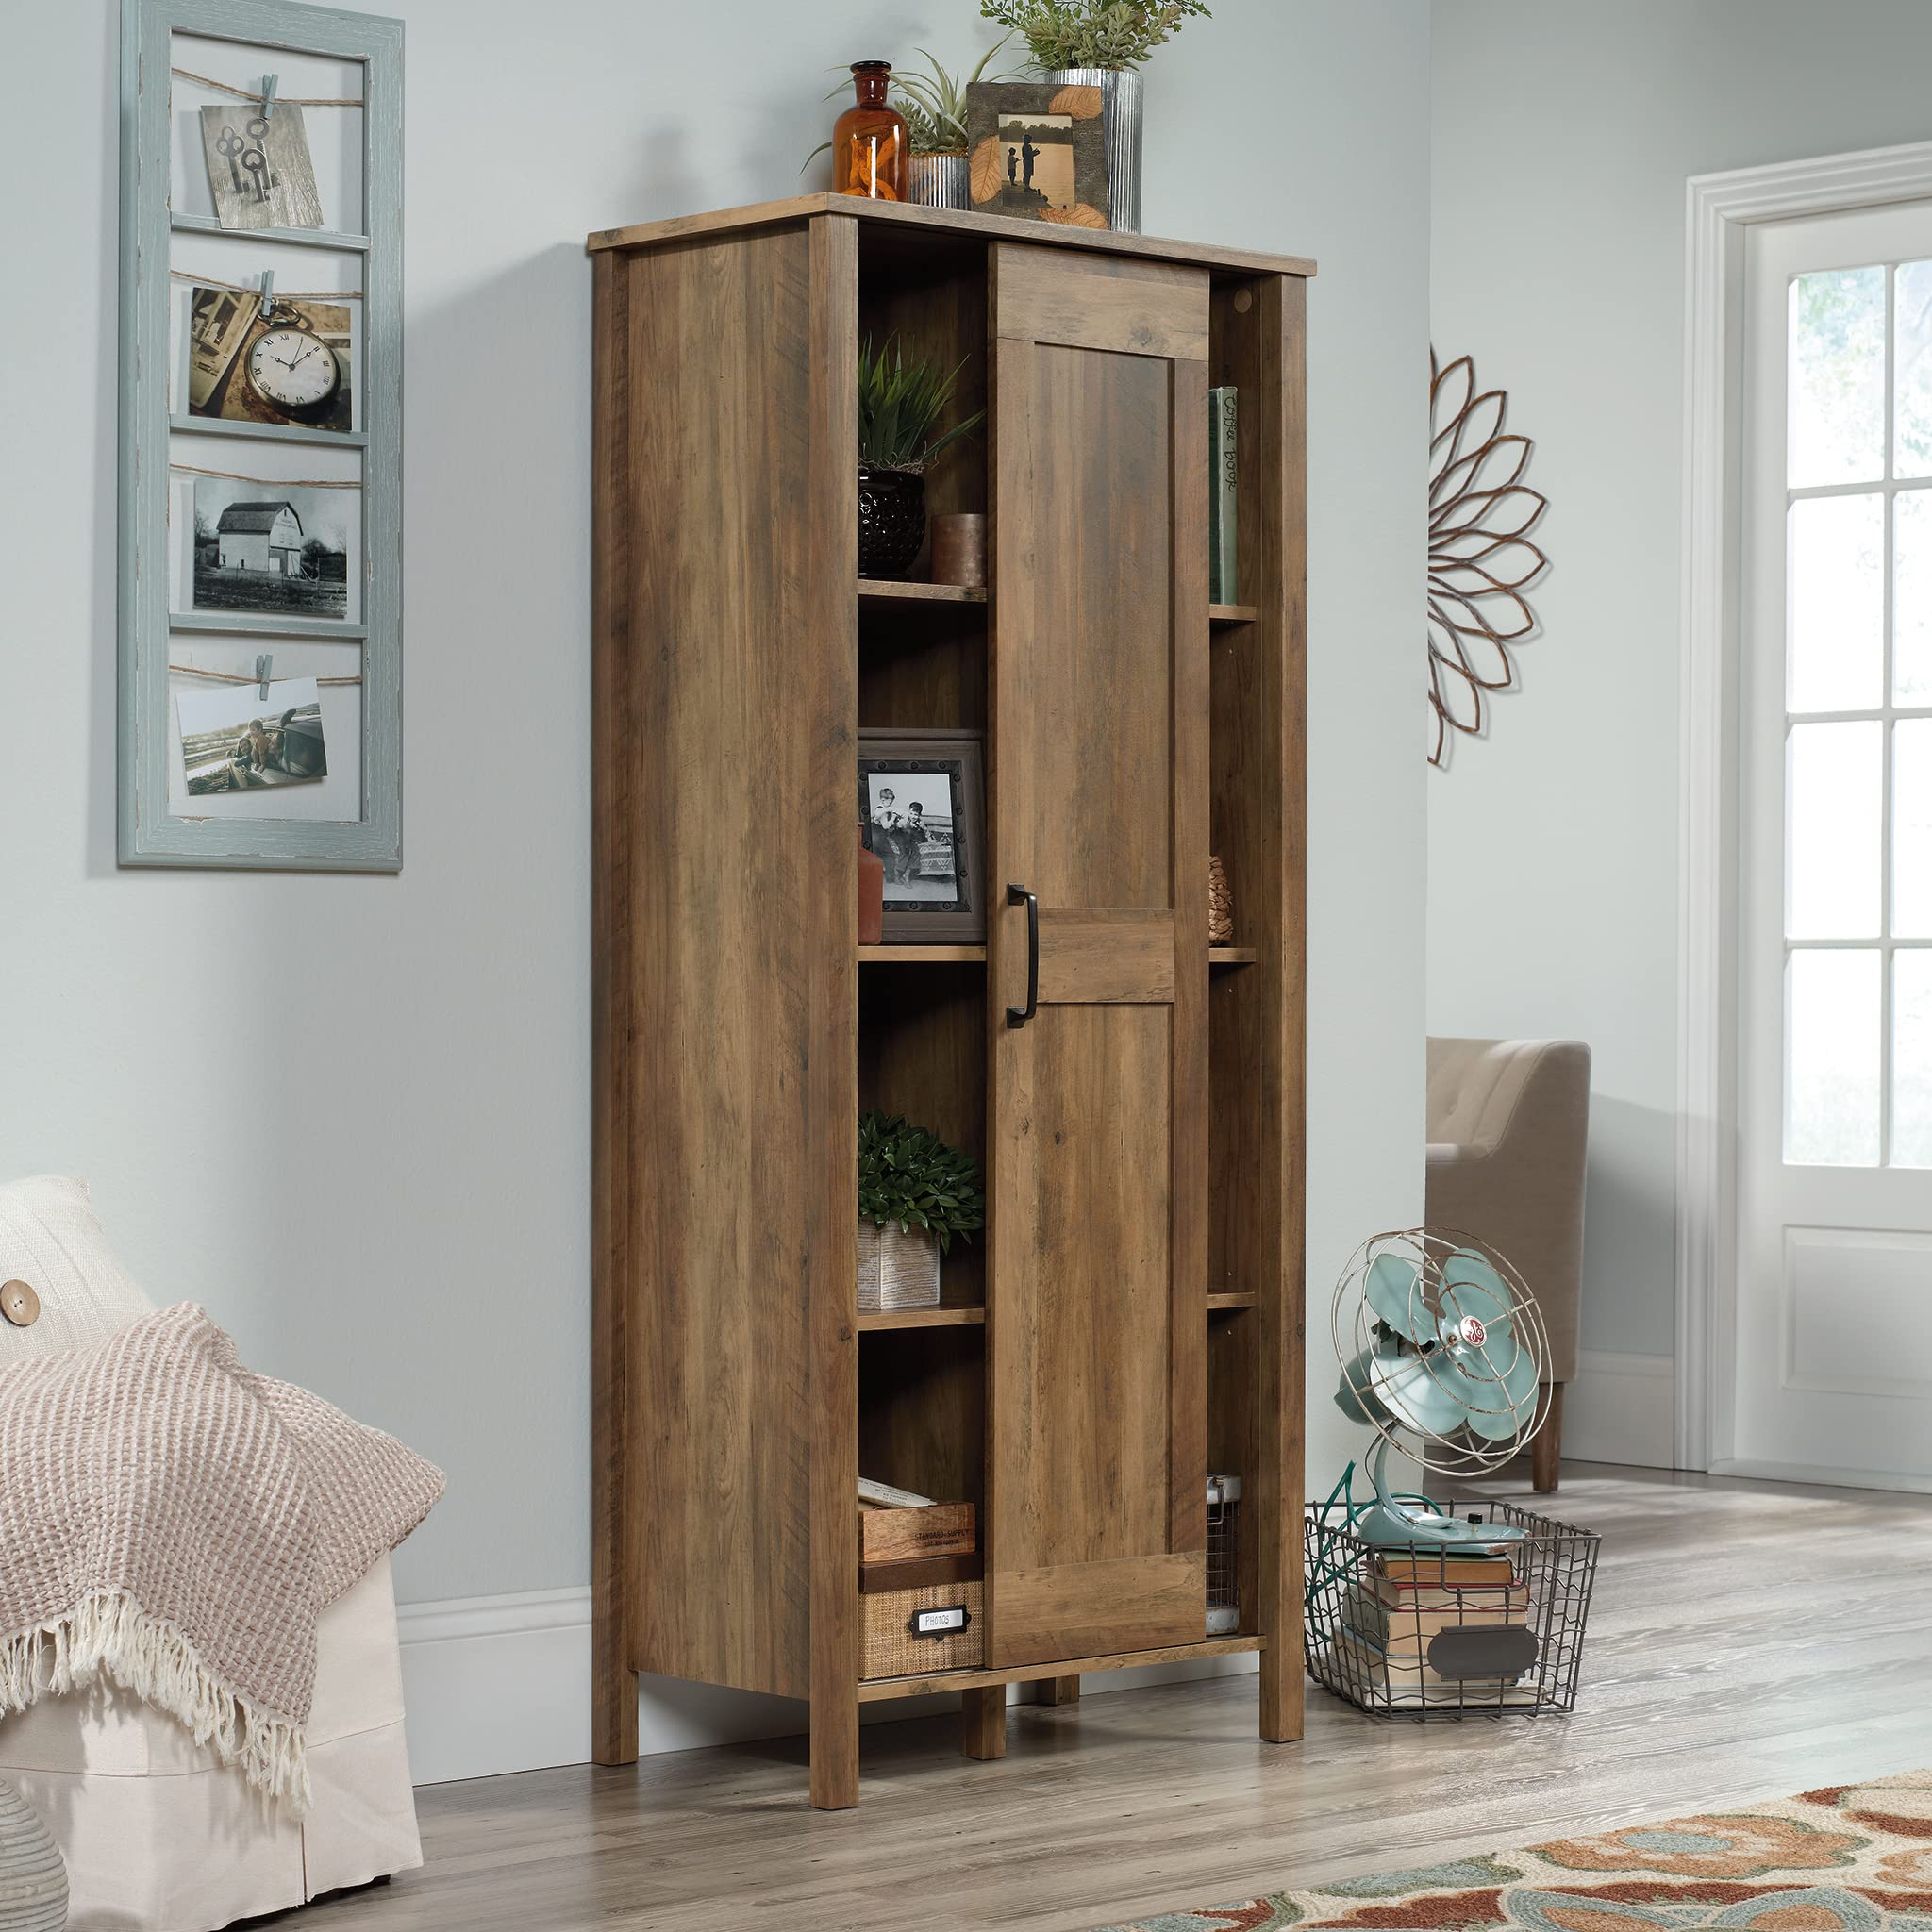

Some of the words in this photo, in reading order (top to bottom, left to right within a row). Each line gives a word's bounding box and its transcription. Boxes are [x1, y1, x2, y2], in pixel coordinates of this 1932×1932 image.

[254, 367, 262, 375] IX
[276, 392, 286, 401] VII
[1224, 395, 1237, 441] Coffee
[1224, 448, 1237, 492] Book
[915, 1531, 943, 1541] STANDARD
[947, 1529, 969, 1538] SUPPLY
[925, 1614, 950, 1626] PHOTOS
